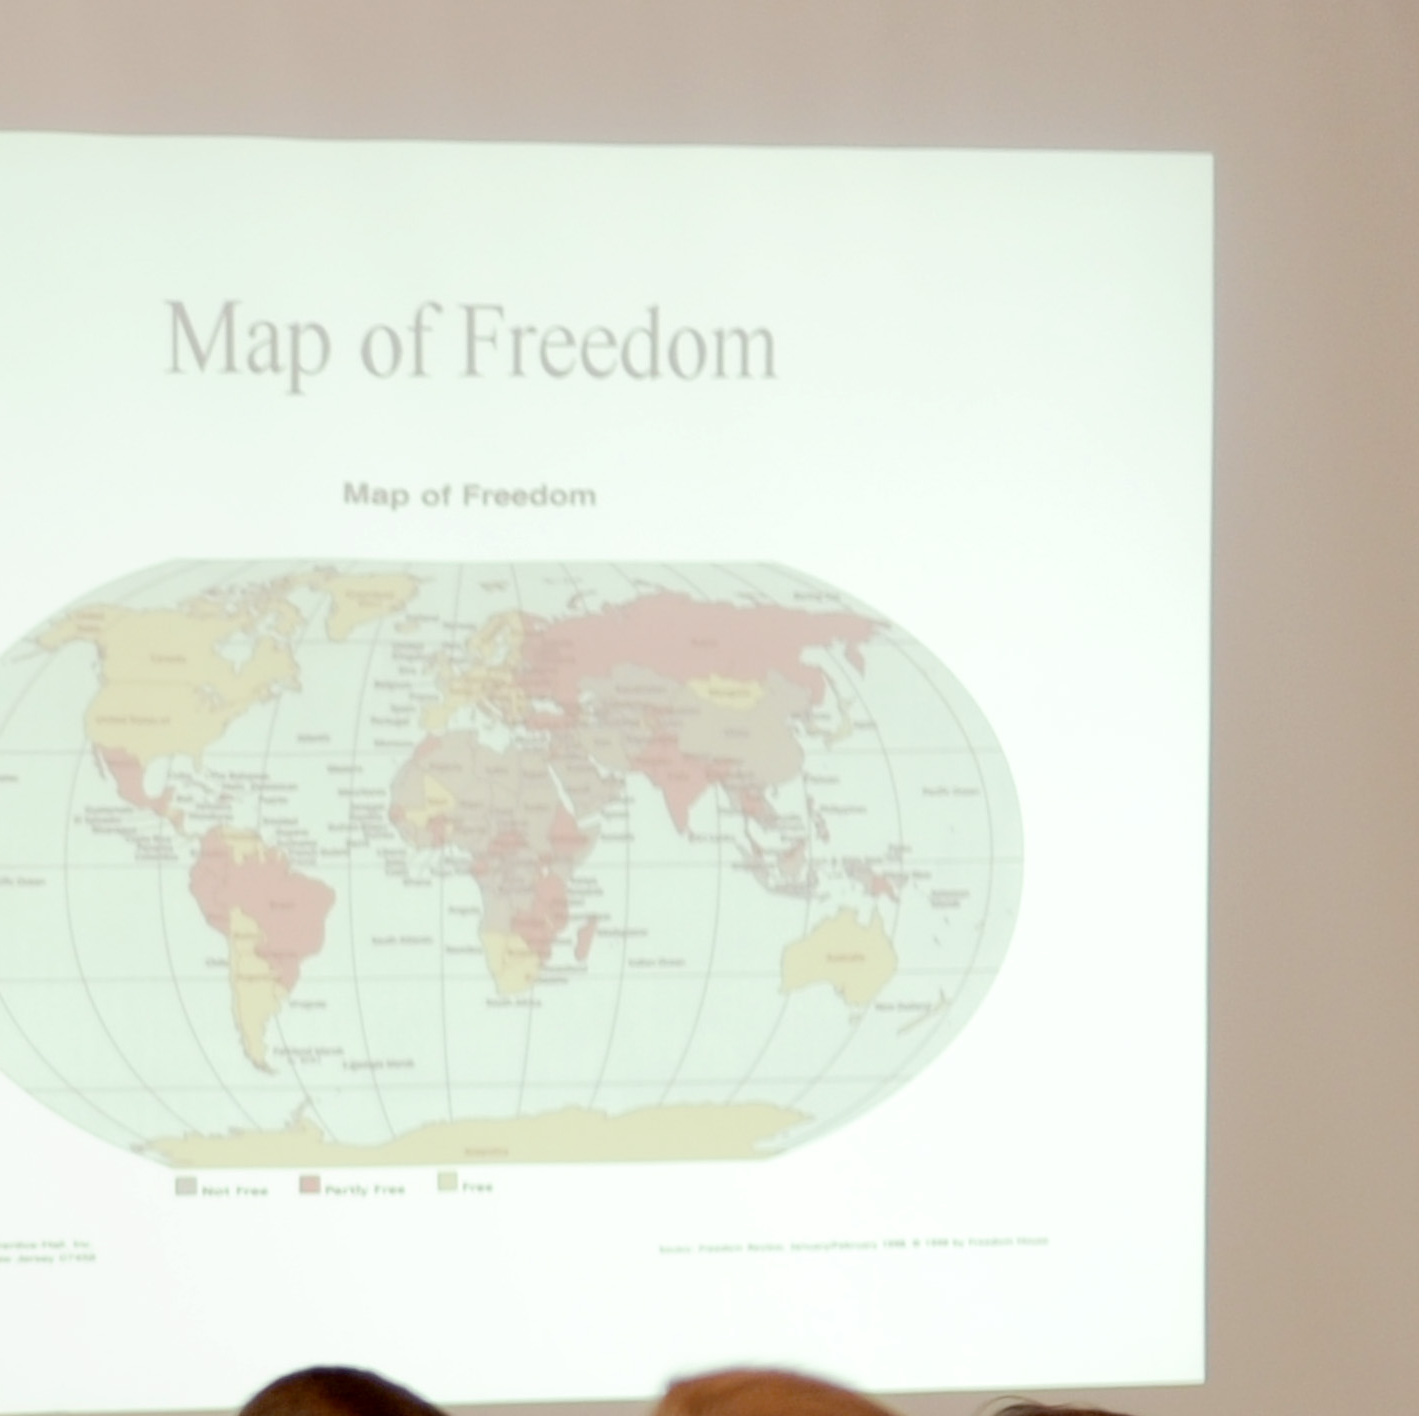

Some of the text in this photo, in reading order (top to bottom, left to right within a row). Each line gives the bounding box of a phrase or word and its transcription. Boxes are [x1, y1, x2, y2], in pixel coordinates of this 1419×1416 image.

[165, 300, 775, 395] Map of Freedom
[344, 482, 596, 511] Map of Freedom
[236, 1185, 268, 1197] Free
[324, 1183, 405, 1198] Partly Free
[462, 1180, 494, 1193] Free
